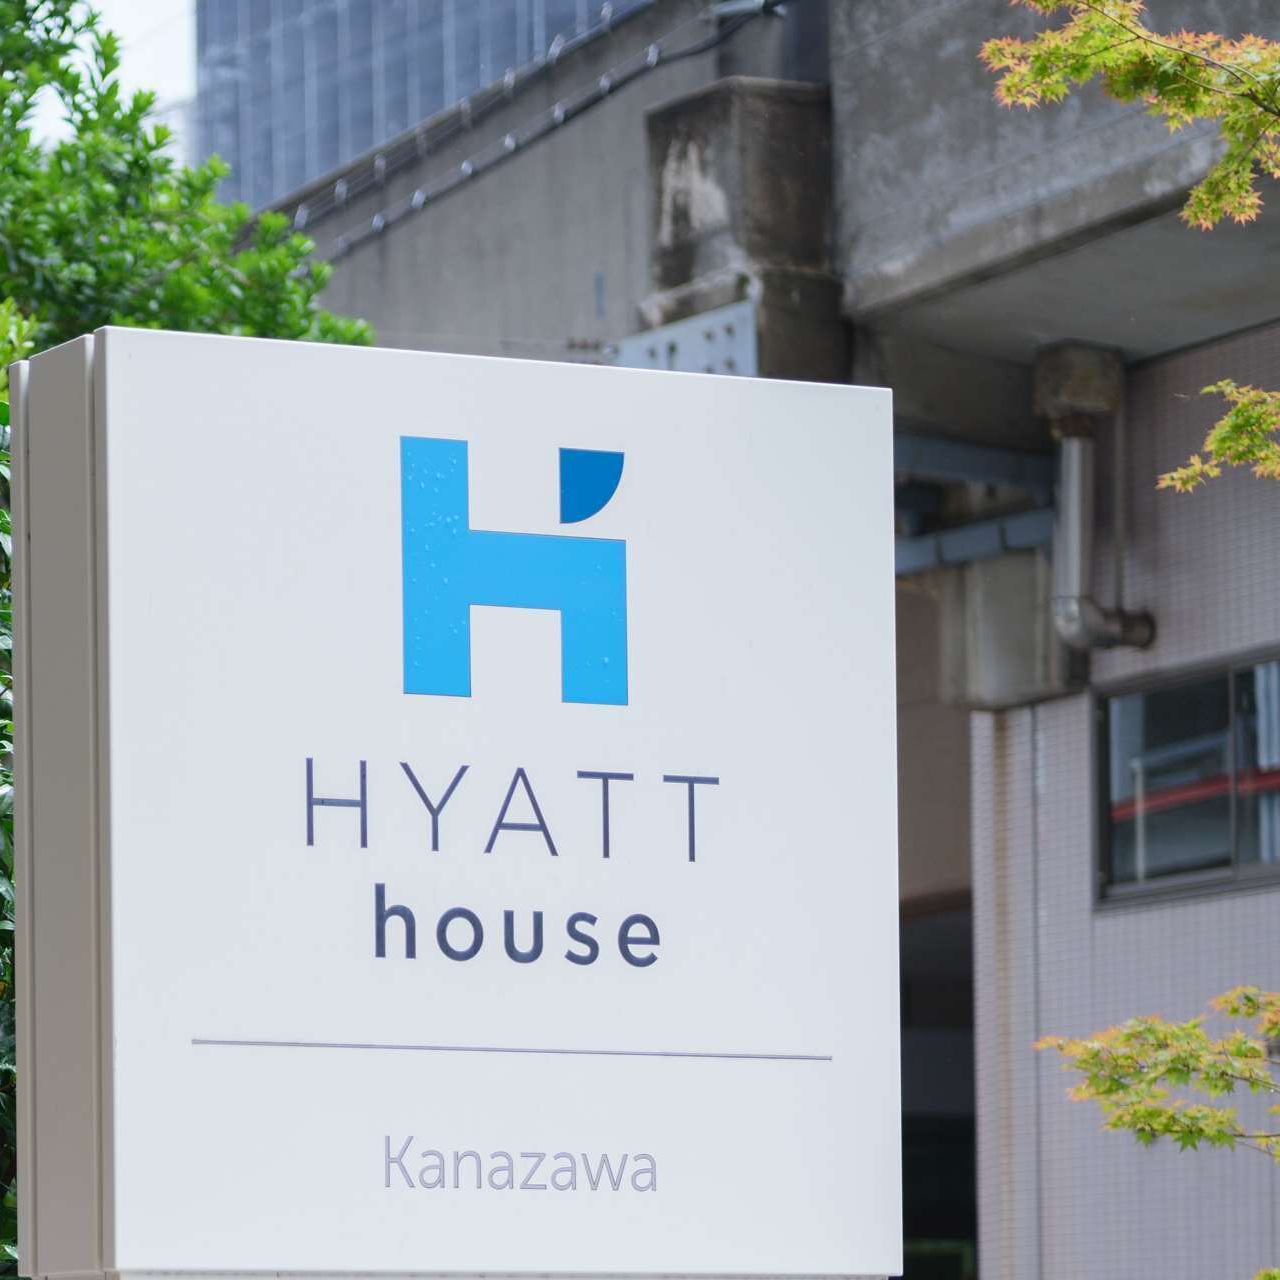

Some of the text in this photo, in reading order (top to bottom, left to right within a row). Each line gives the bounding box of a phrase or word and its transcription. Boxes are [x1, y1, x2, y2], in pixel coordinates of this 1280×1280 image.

[304, 756, 720, 864] HYATT
[373, 881, 662, 969] house
[384, 1135, 658, 1193] Kanazawa
